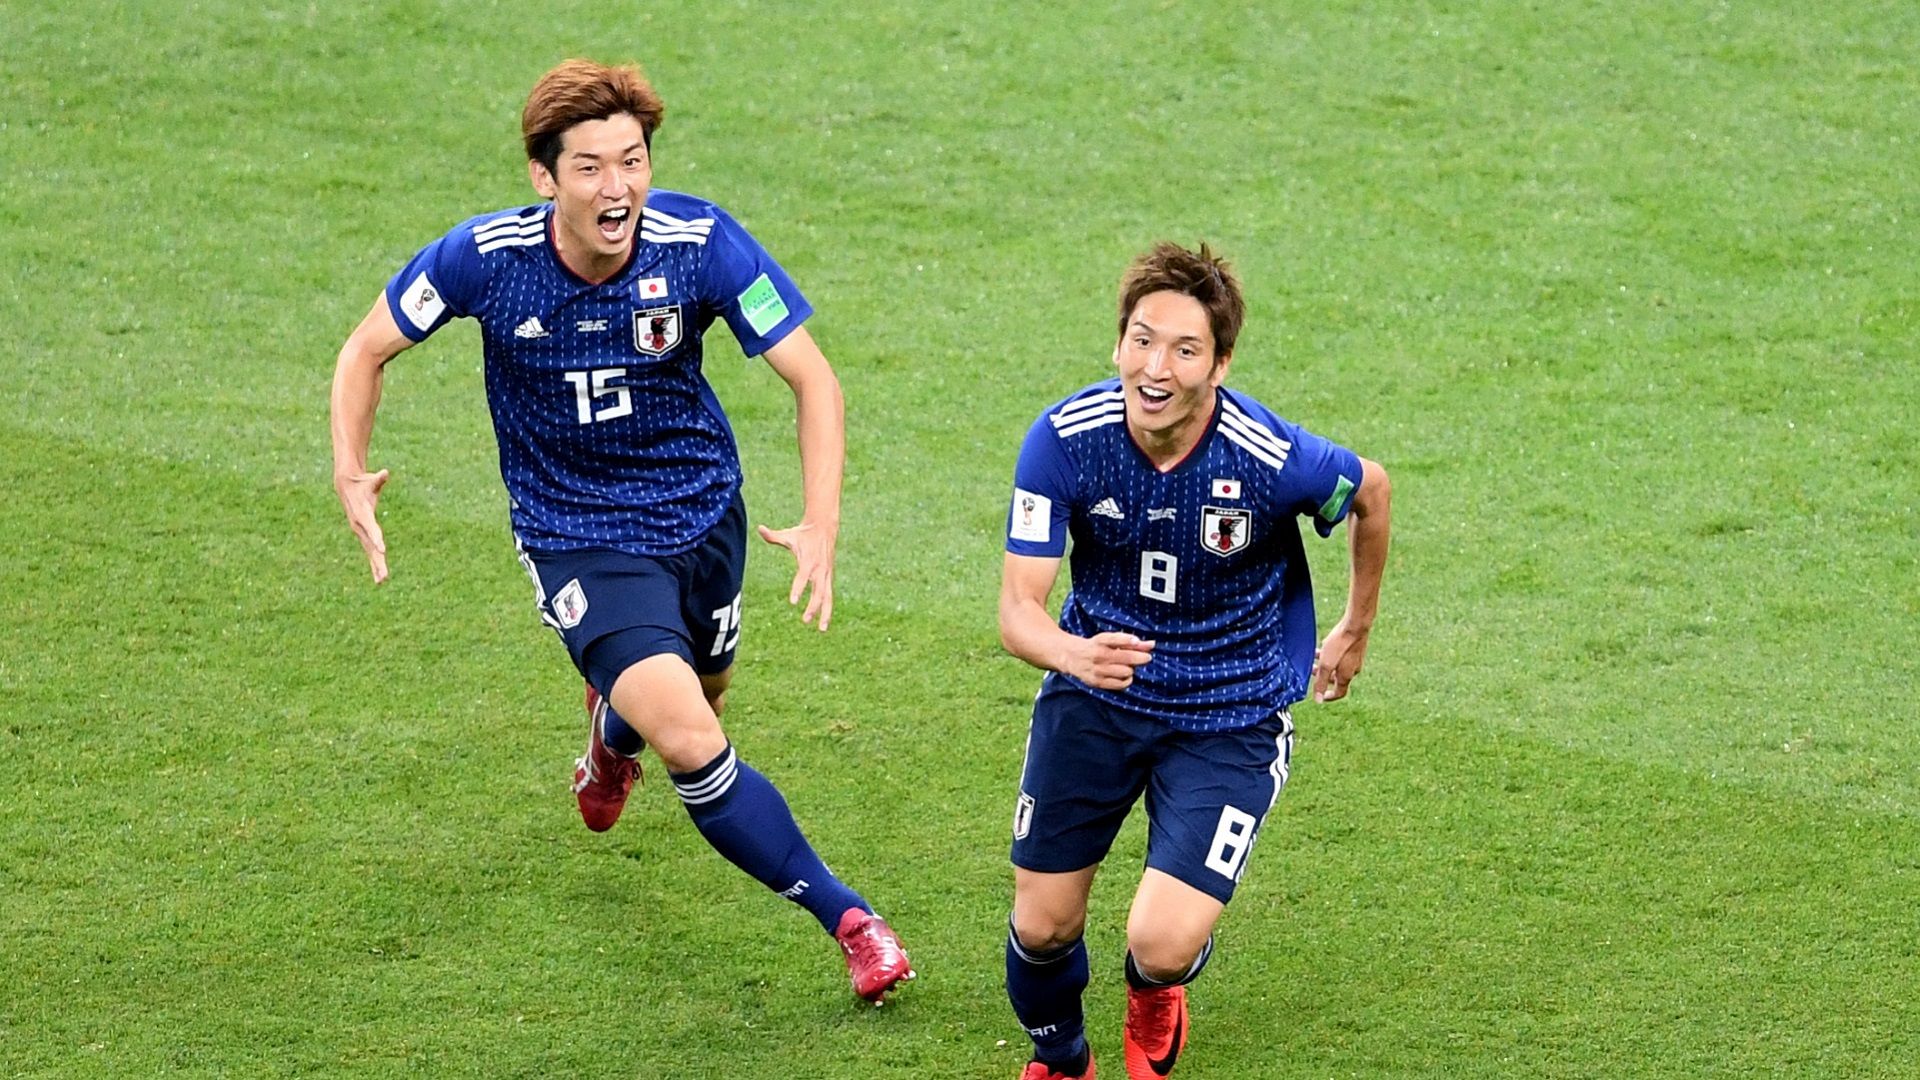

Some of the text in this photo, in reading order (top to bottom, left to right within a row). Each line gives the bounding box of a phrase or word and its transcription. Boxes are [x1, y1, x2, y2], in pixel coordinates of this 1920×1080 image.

[564, 368, 633, 425] 15
[1090, 507, 1124, 519] adidas
[1139, 551, 1178, 603] 8
[1204, 804, 1256, 880] 8
